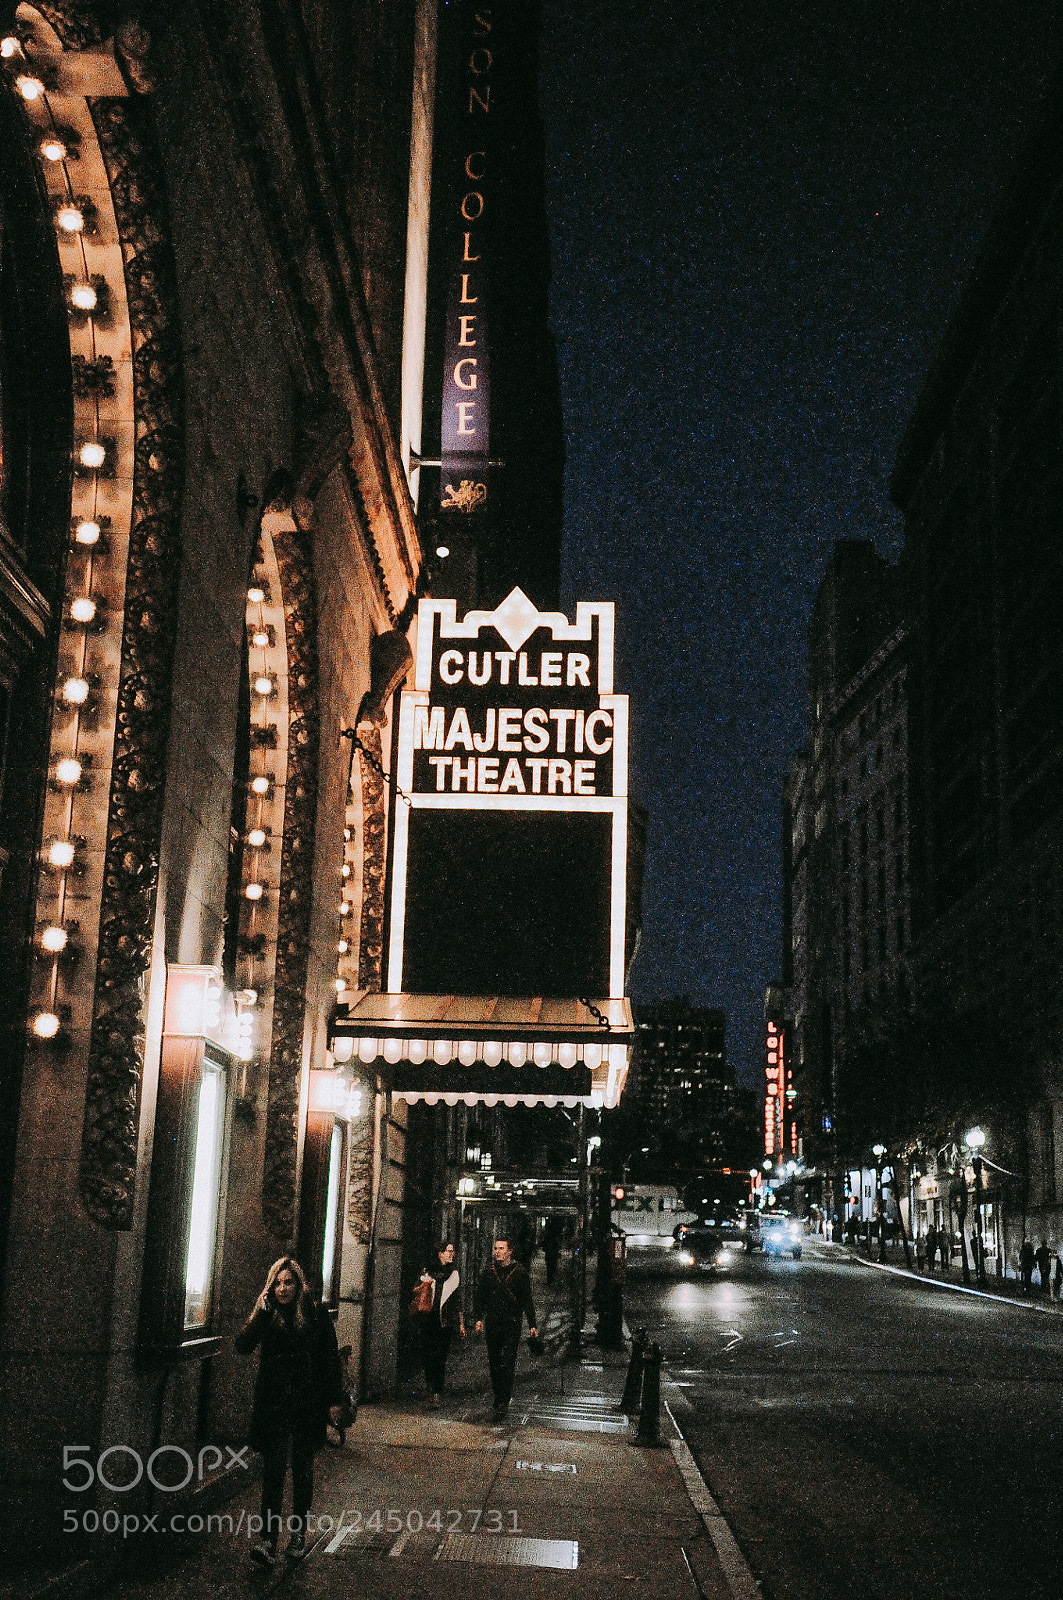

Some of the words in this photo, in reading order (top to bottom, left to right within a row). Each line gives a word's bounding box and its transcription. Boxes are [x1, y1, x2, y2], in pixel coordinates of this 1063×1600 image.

[453, 150, 487, 436] COLLEGE
[439, 649, 591, 687] CUTLER
[413, 706, 613, 755] MAJESTIC
[428, 756, 597, 795] THEATRE
